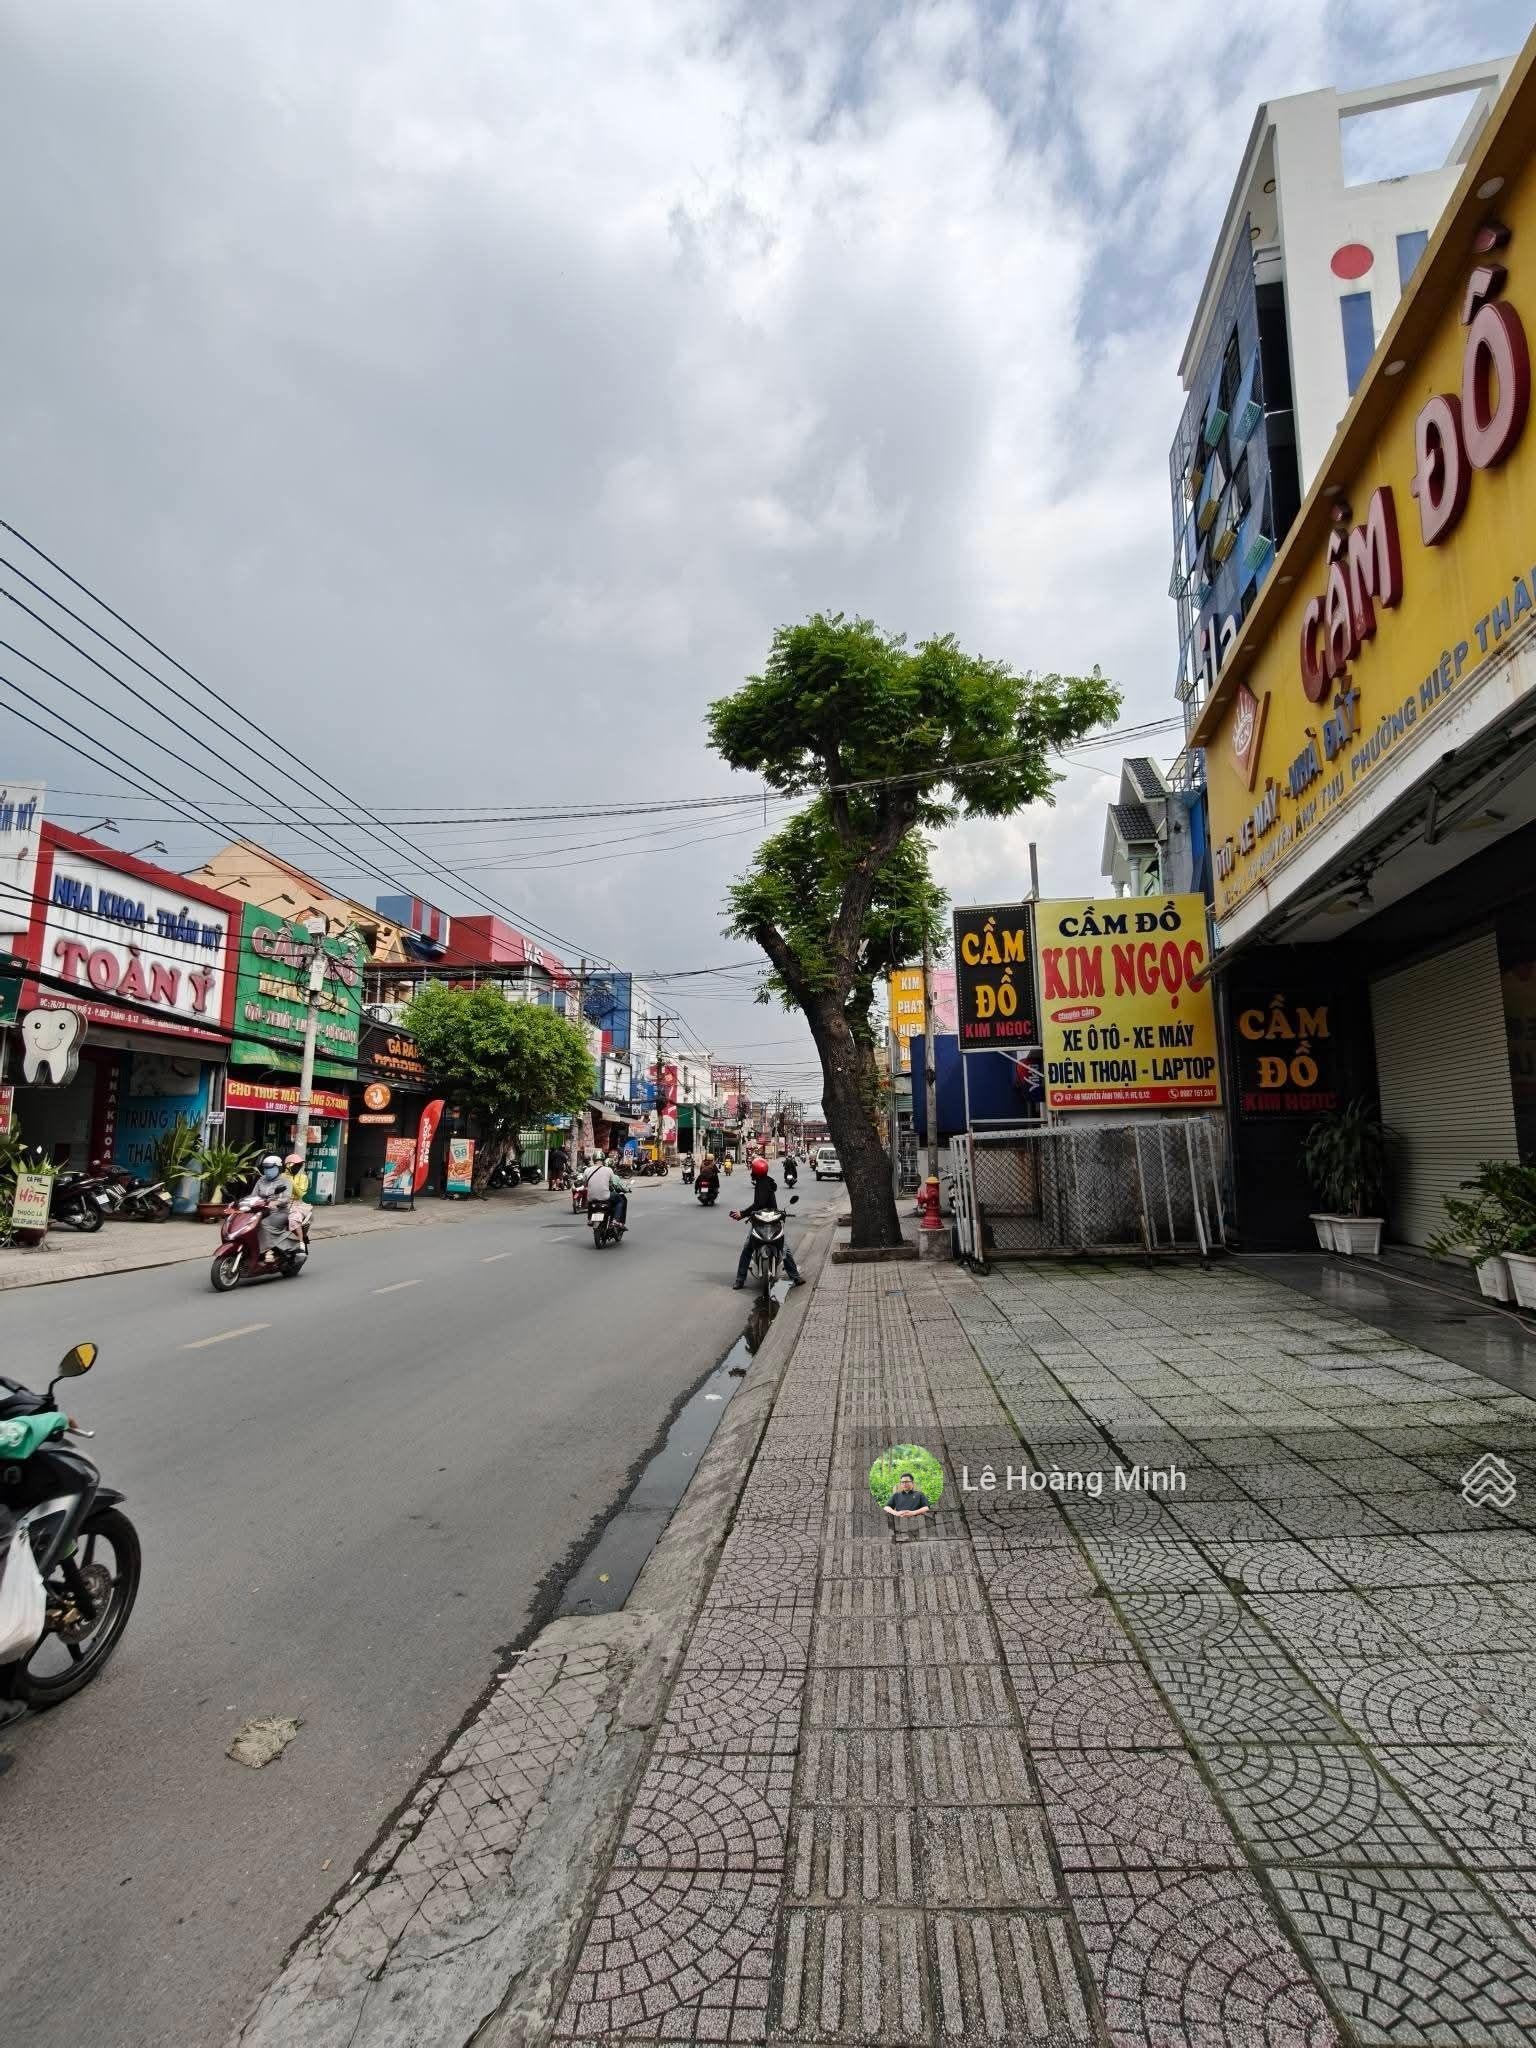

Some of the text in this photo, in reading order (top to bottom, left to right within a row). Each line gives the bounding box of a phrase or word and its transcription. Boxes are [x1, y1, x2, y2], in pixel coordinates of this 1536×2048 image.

[1300, 226, 1531, 703] CẦM ĐỒ
[1351, 697, 1417, 780] PHƯỜNG
[1419, 640, 1469, 713] HIỆP
[1253, 776, 1282, 839] MÁY
[1289, 727, 1323, 799] NHÀ
[1323, 676, 1361, 761] ĐẤT
[53, 874, 93, 914] NHA
[97, 888, 146, 930] KHOA
[1058, 901, 1182, 938] CẦM ĐỒ
[961, 916, 1026, 966] CẦM
[55, 936, 182, 1007] TOÀN
[901, 976, 921, 990] KIM
[975, 966, 1018, 1019] ĐỒ
[1042, 939, 1206, 1010] KIM NGỌC
[965, 1021, 1031, 1039] KIM NGỌC
[1062, 1030, 1083, 1052] XE
[1133, 1026, 1154, 1049] XE
[1158, 1020, 1195, 1049] MÁY
[1239, 993, 1331, 1040] CẦM
[1048, 1058, 1086, 1088] ĐIỆN
[1090, 1060, 1137, 1086] THOẠI
[1152, 1056, 1216, 1081] LAPTOP
[1257, 1040, 1319, 1088] ĐỒ
[228, 1082, 252, 1097] CHO
[308, 1089, 325, 1106] ẰNG
